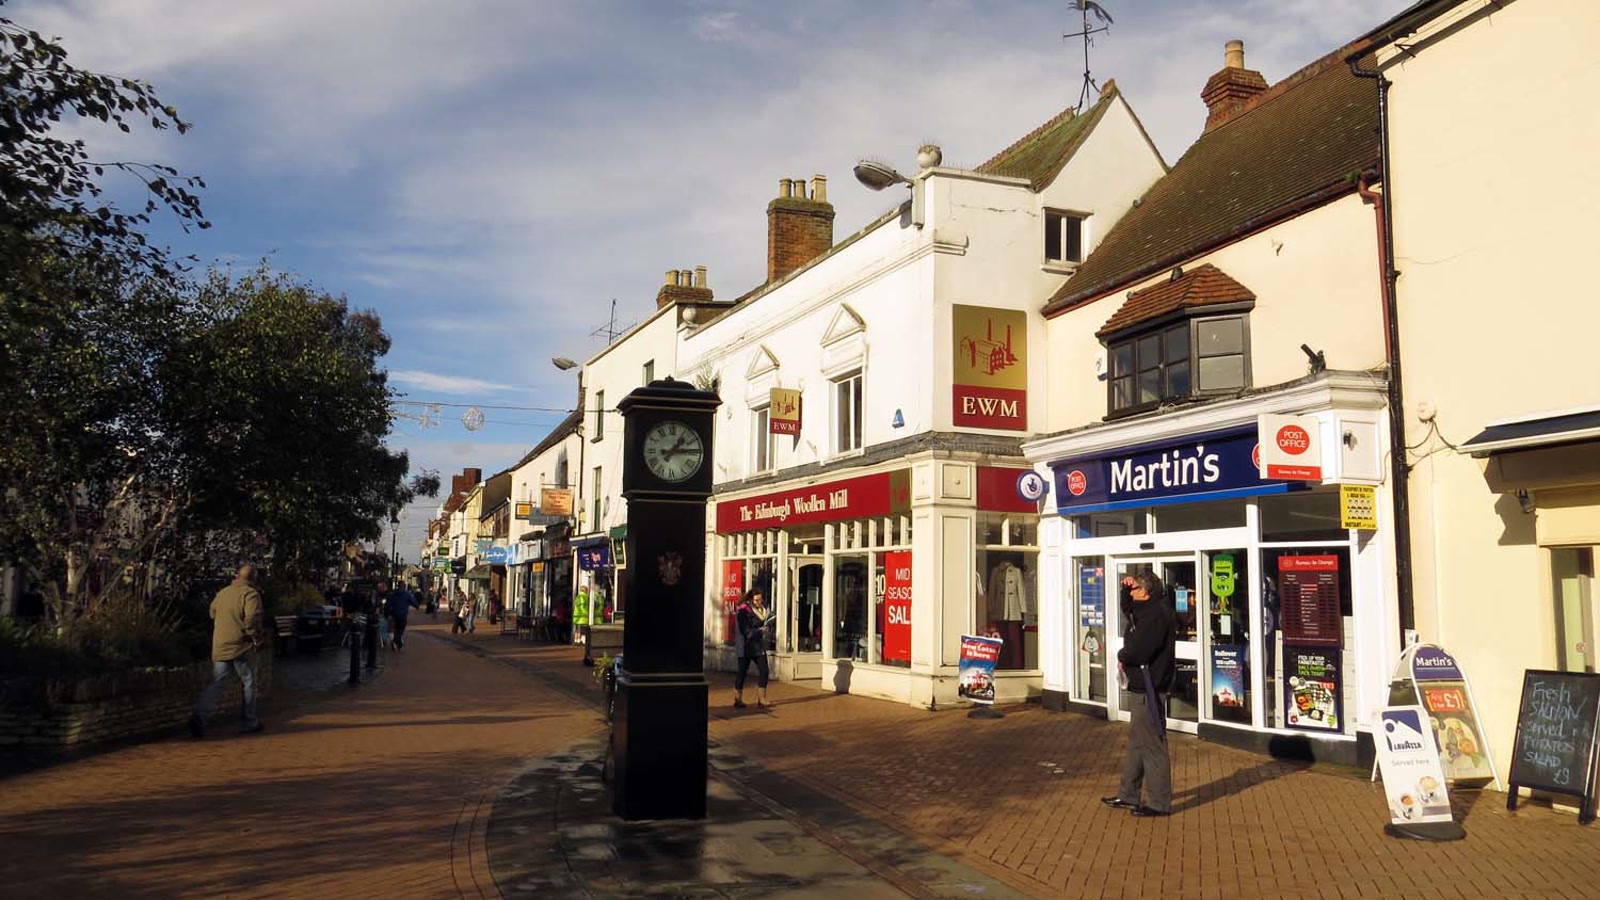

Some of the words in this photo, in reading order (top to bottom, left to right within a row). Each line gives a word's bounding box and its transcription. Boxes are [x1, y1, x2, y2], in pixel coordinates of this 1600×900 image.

[962, 396, 1018, 417] EWM
[773, 421, 796, 431] EWM
[1283, 431, 1303, 439] POST
[1280, 439, 1306, 447] OFFICE
[1110, 445, 1219, 493] Martin's
[740, 506, 752, 521] The
[755, 499, 790, 521] Edinburgh
[793, 494, 826, 514] Woollen
[830, 489, 848, 509] Mill
[896, 568, 910, 581] MID
[876, 574, 886, 595] 10
[888, 586, 912, 600] SEASO
[888, 605, 910, 625] SAL
[974, 651, 990, 659] here
[978, 645, 996, 653] Lotto
[1416, 657, 1453, 666] Martin's
[1533, 681, 1570, 703] Fresh
[1444, 692, 1460, 709] £1
[1529, 696, 1587, 720] SALMON
[1392, 759, 1414, 767] Served
[1524, 751, 1561, 767] SALAD
